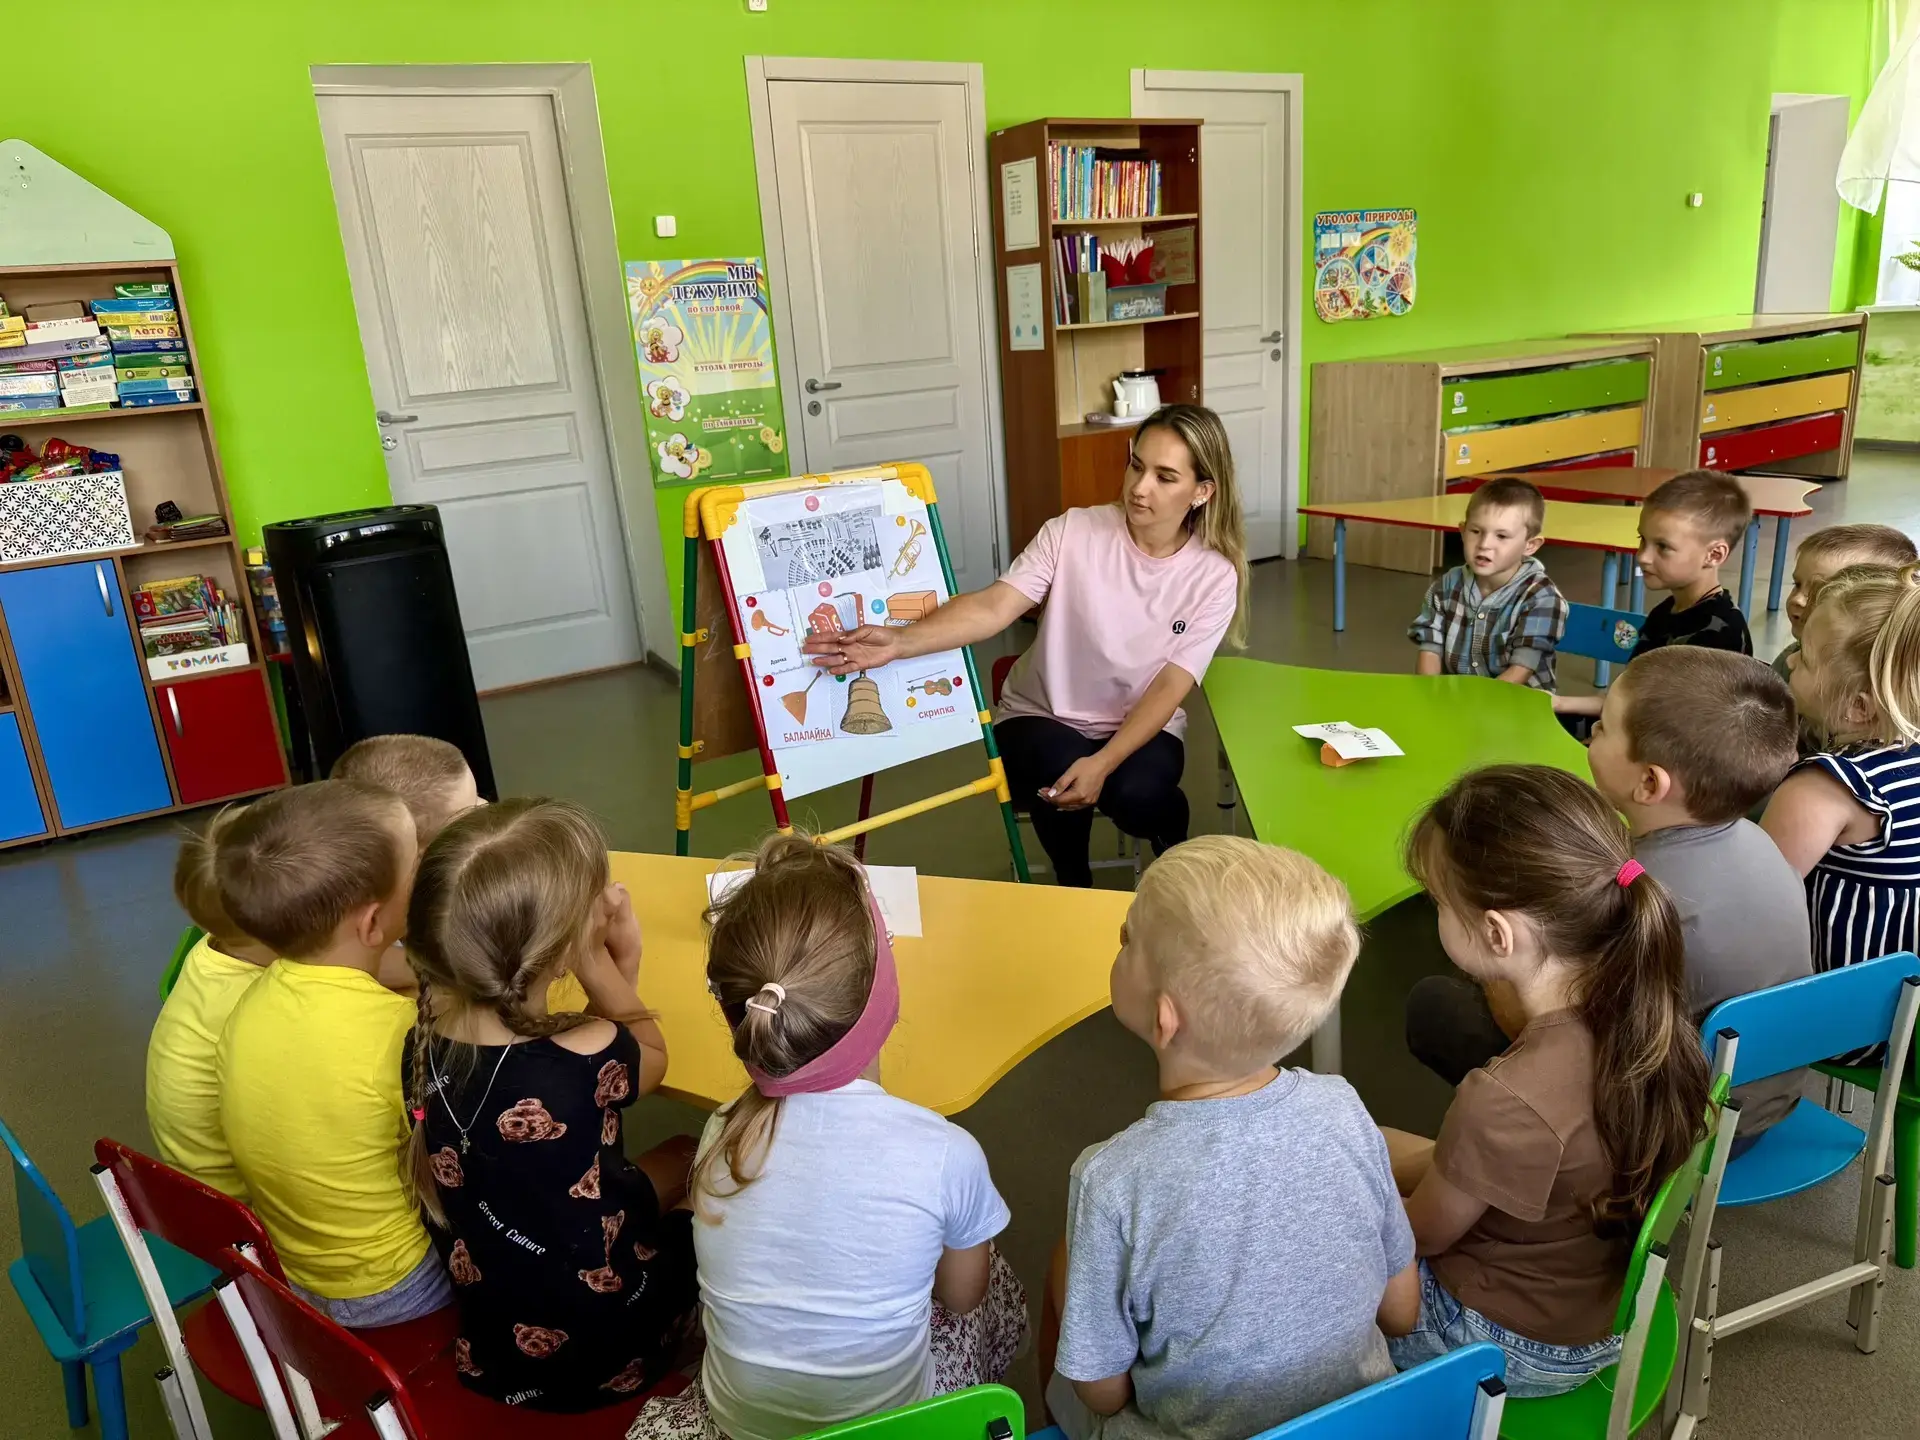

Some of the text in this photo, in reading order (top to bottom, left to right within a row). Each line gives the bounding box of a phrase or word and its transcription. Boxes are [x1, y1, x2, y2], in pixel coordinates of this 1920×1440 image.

[1317, 211, 1414, 225] УГОЛОК ПРИРОДЫ
[727, 266, 756, 281] МЫ
[672, 283, 758, 303] ДЕЖУРИМ!
[687, 304, 744, 314] ПО СТОЛОВОЙ:
[134, 327, 164, 336] ЛОТО
[167, 652, 230, 671] ТОМИК
[918, 705, 956, 720] скрипка
[783, 728, 833, 743] БАЛАЛАЙКА
[478, 1200, 547, 1255] Street Culture
